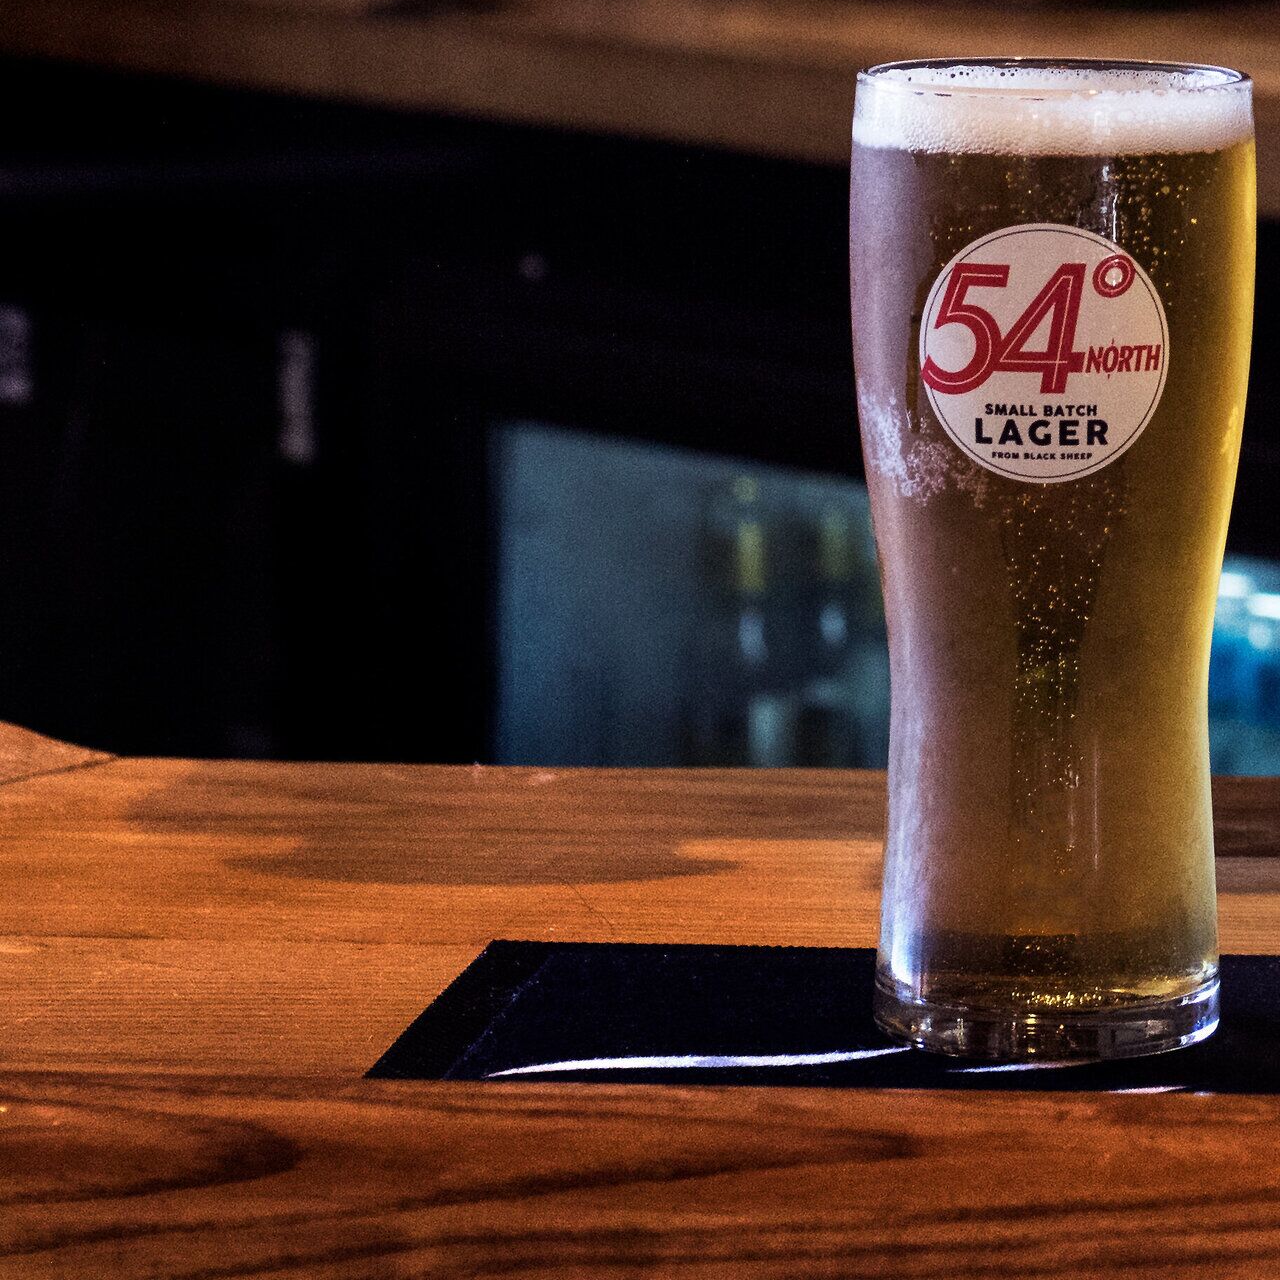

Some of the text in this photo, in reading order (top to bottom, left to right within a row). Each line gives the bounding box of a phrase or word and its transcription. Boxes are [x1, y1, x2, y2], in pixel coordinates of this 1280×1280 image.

[1085, 342, 1161, 376] NORTH
[985, 403, 1097, 417] SMALL BATCH
[975, 418, 1108, 446] LAGER
[1024, 452, 1056, 460] BLACK
